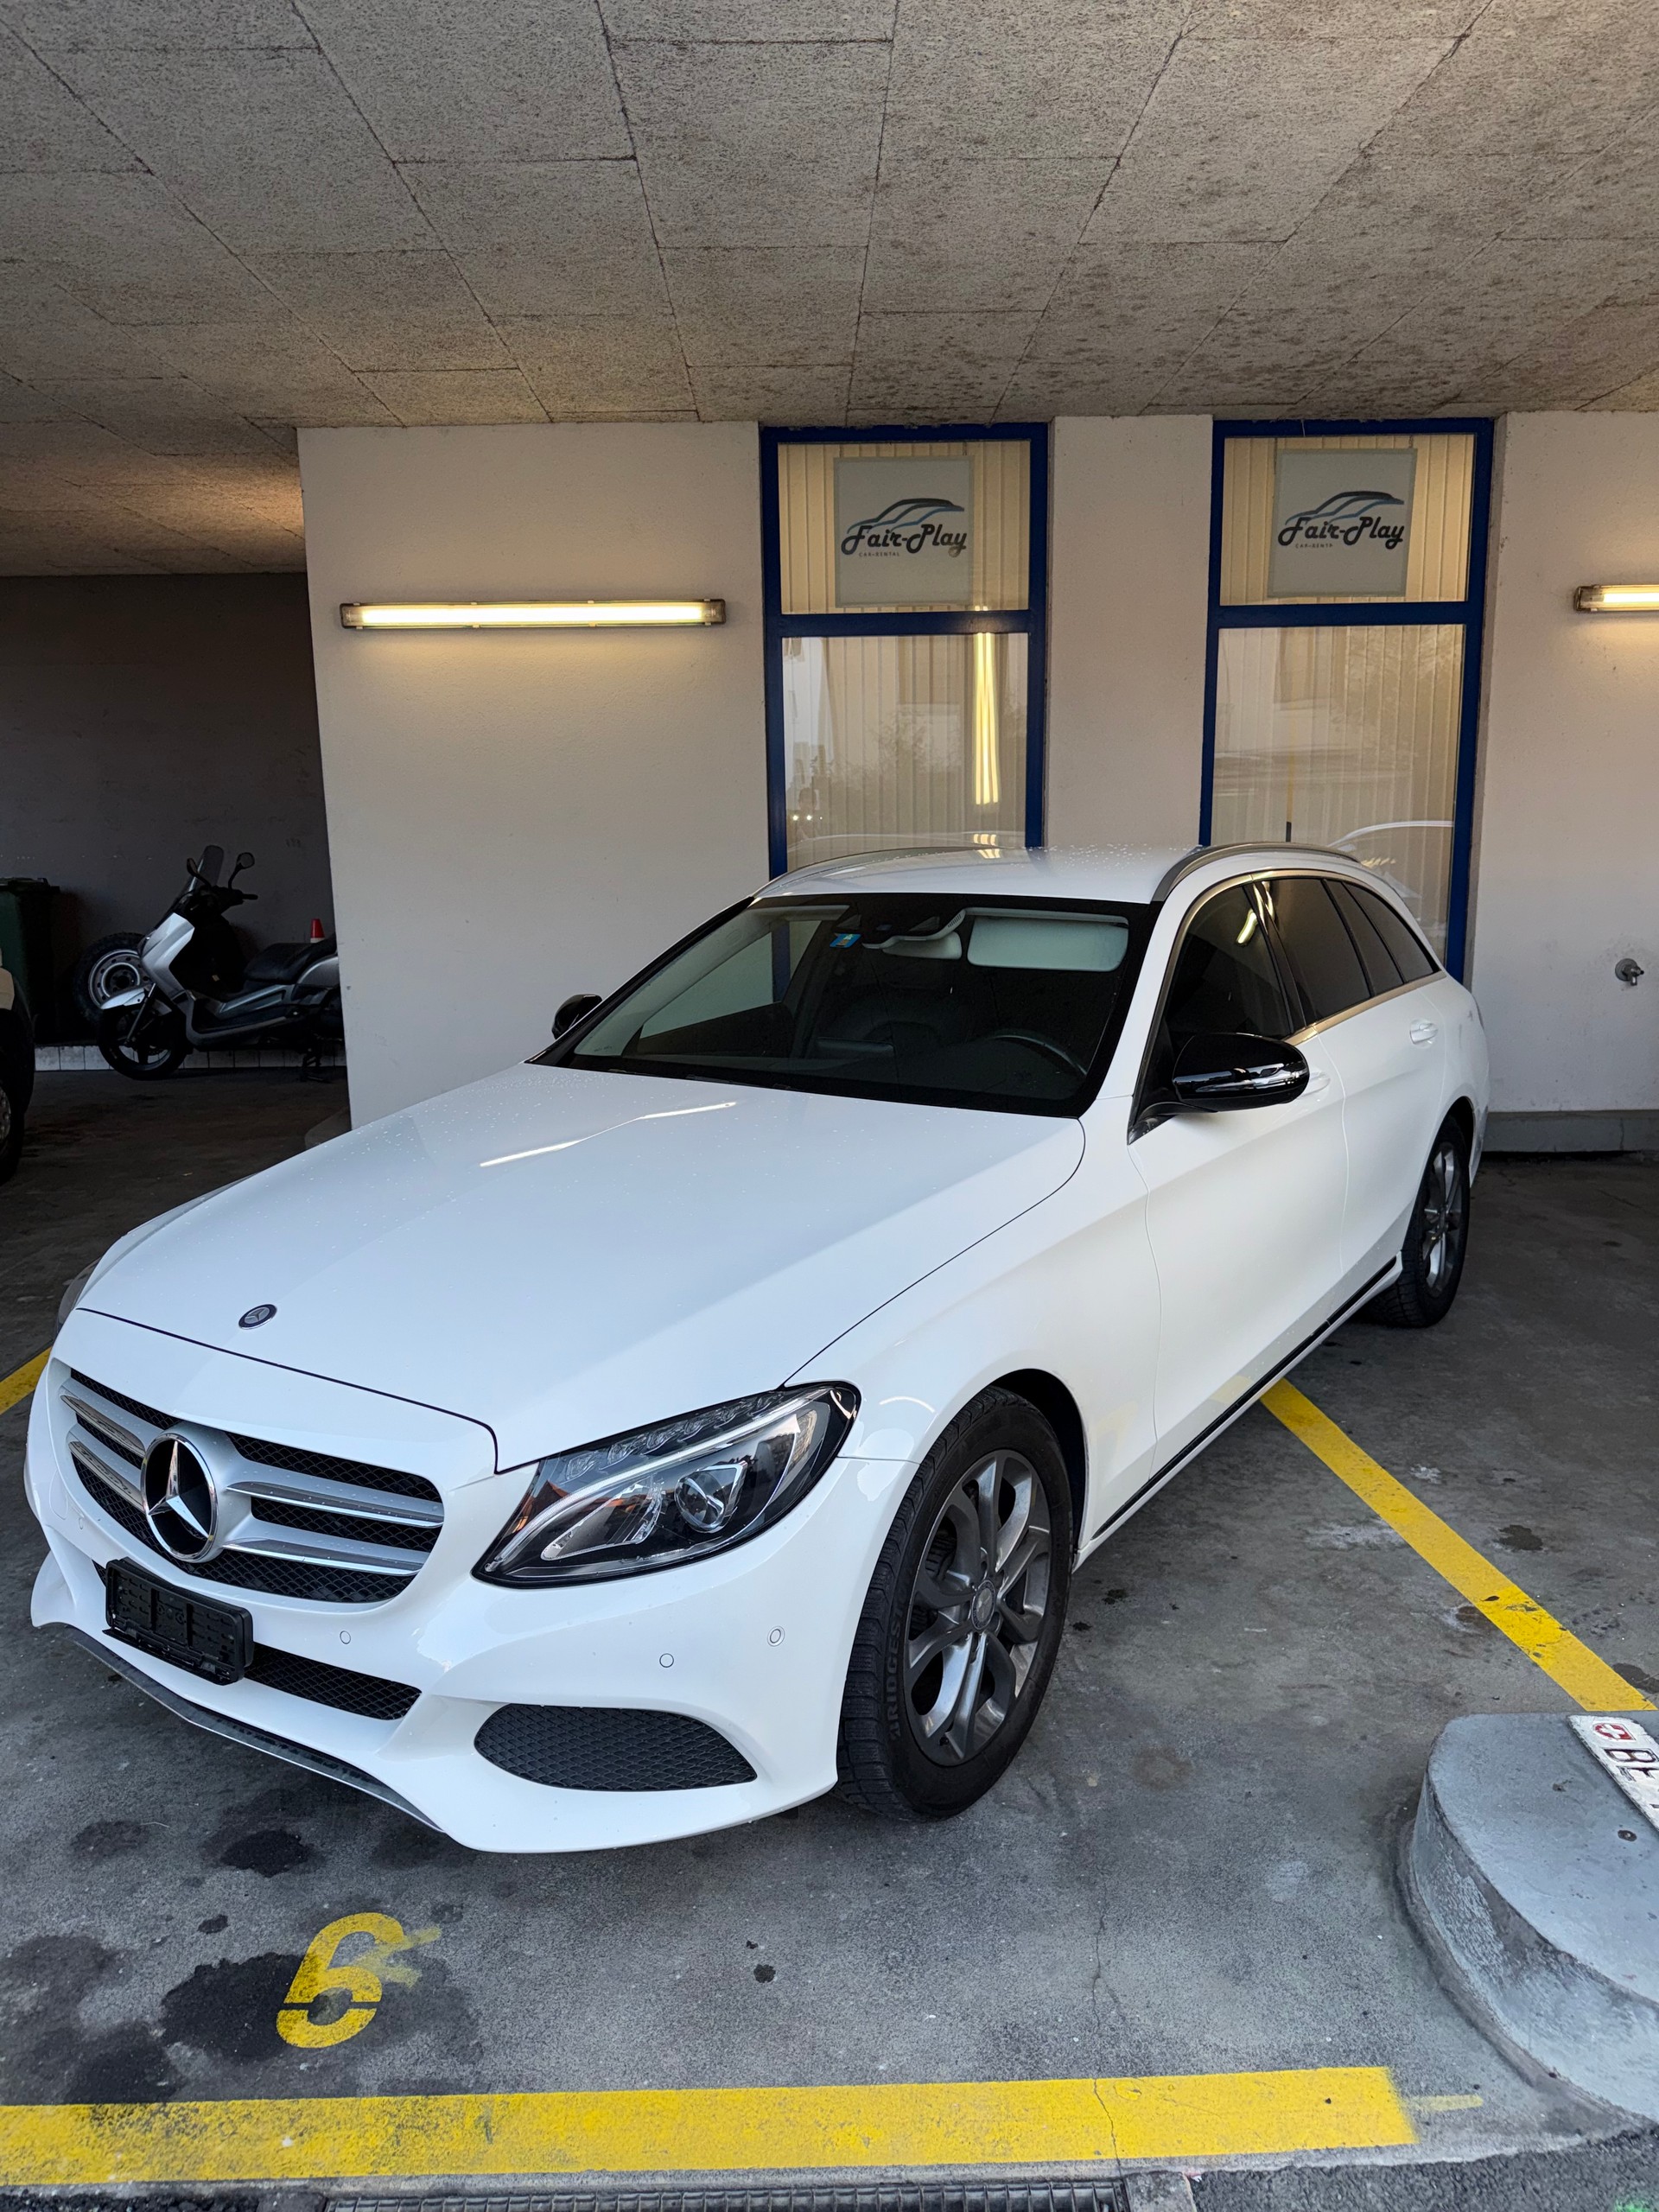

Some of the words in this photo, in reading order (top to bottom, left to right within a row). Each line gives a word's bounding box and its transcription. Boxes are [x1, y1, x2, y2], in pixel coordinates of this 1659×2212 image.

[841, 524, 968, 558] Fair-Play
[1278, 517, 1405, 550] Fair-Play
[276, 1912, 404, 2049] 6
